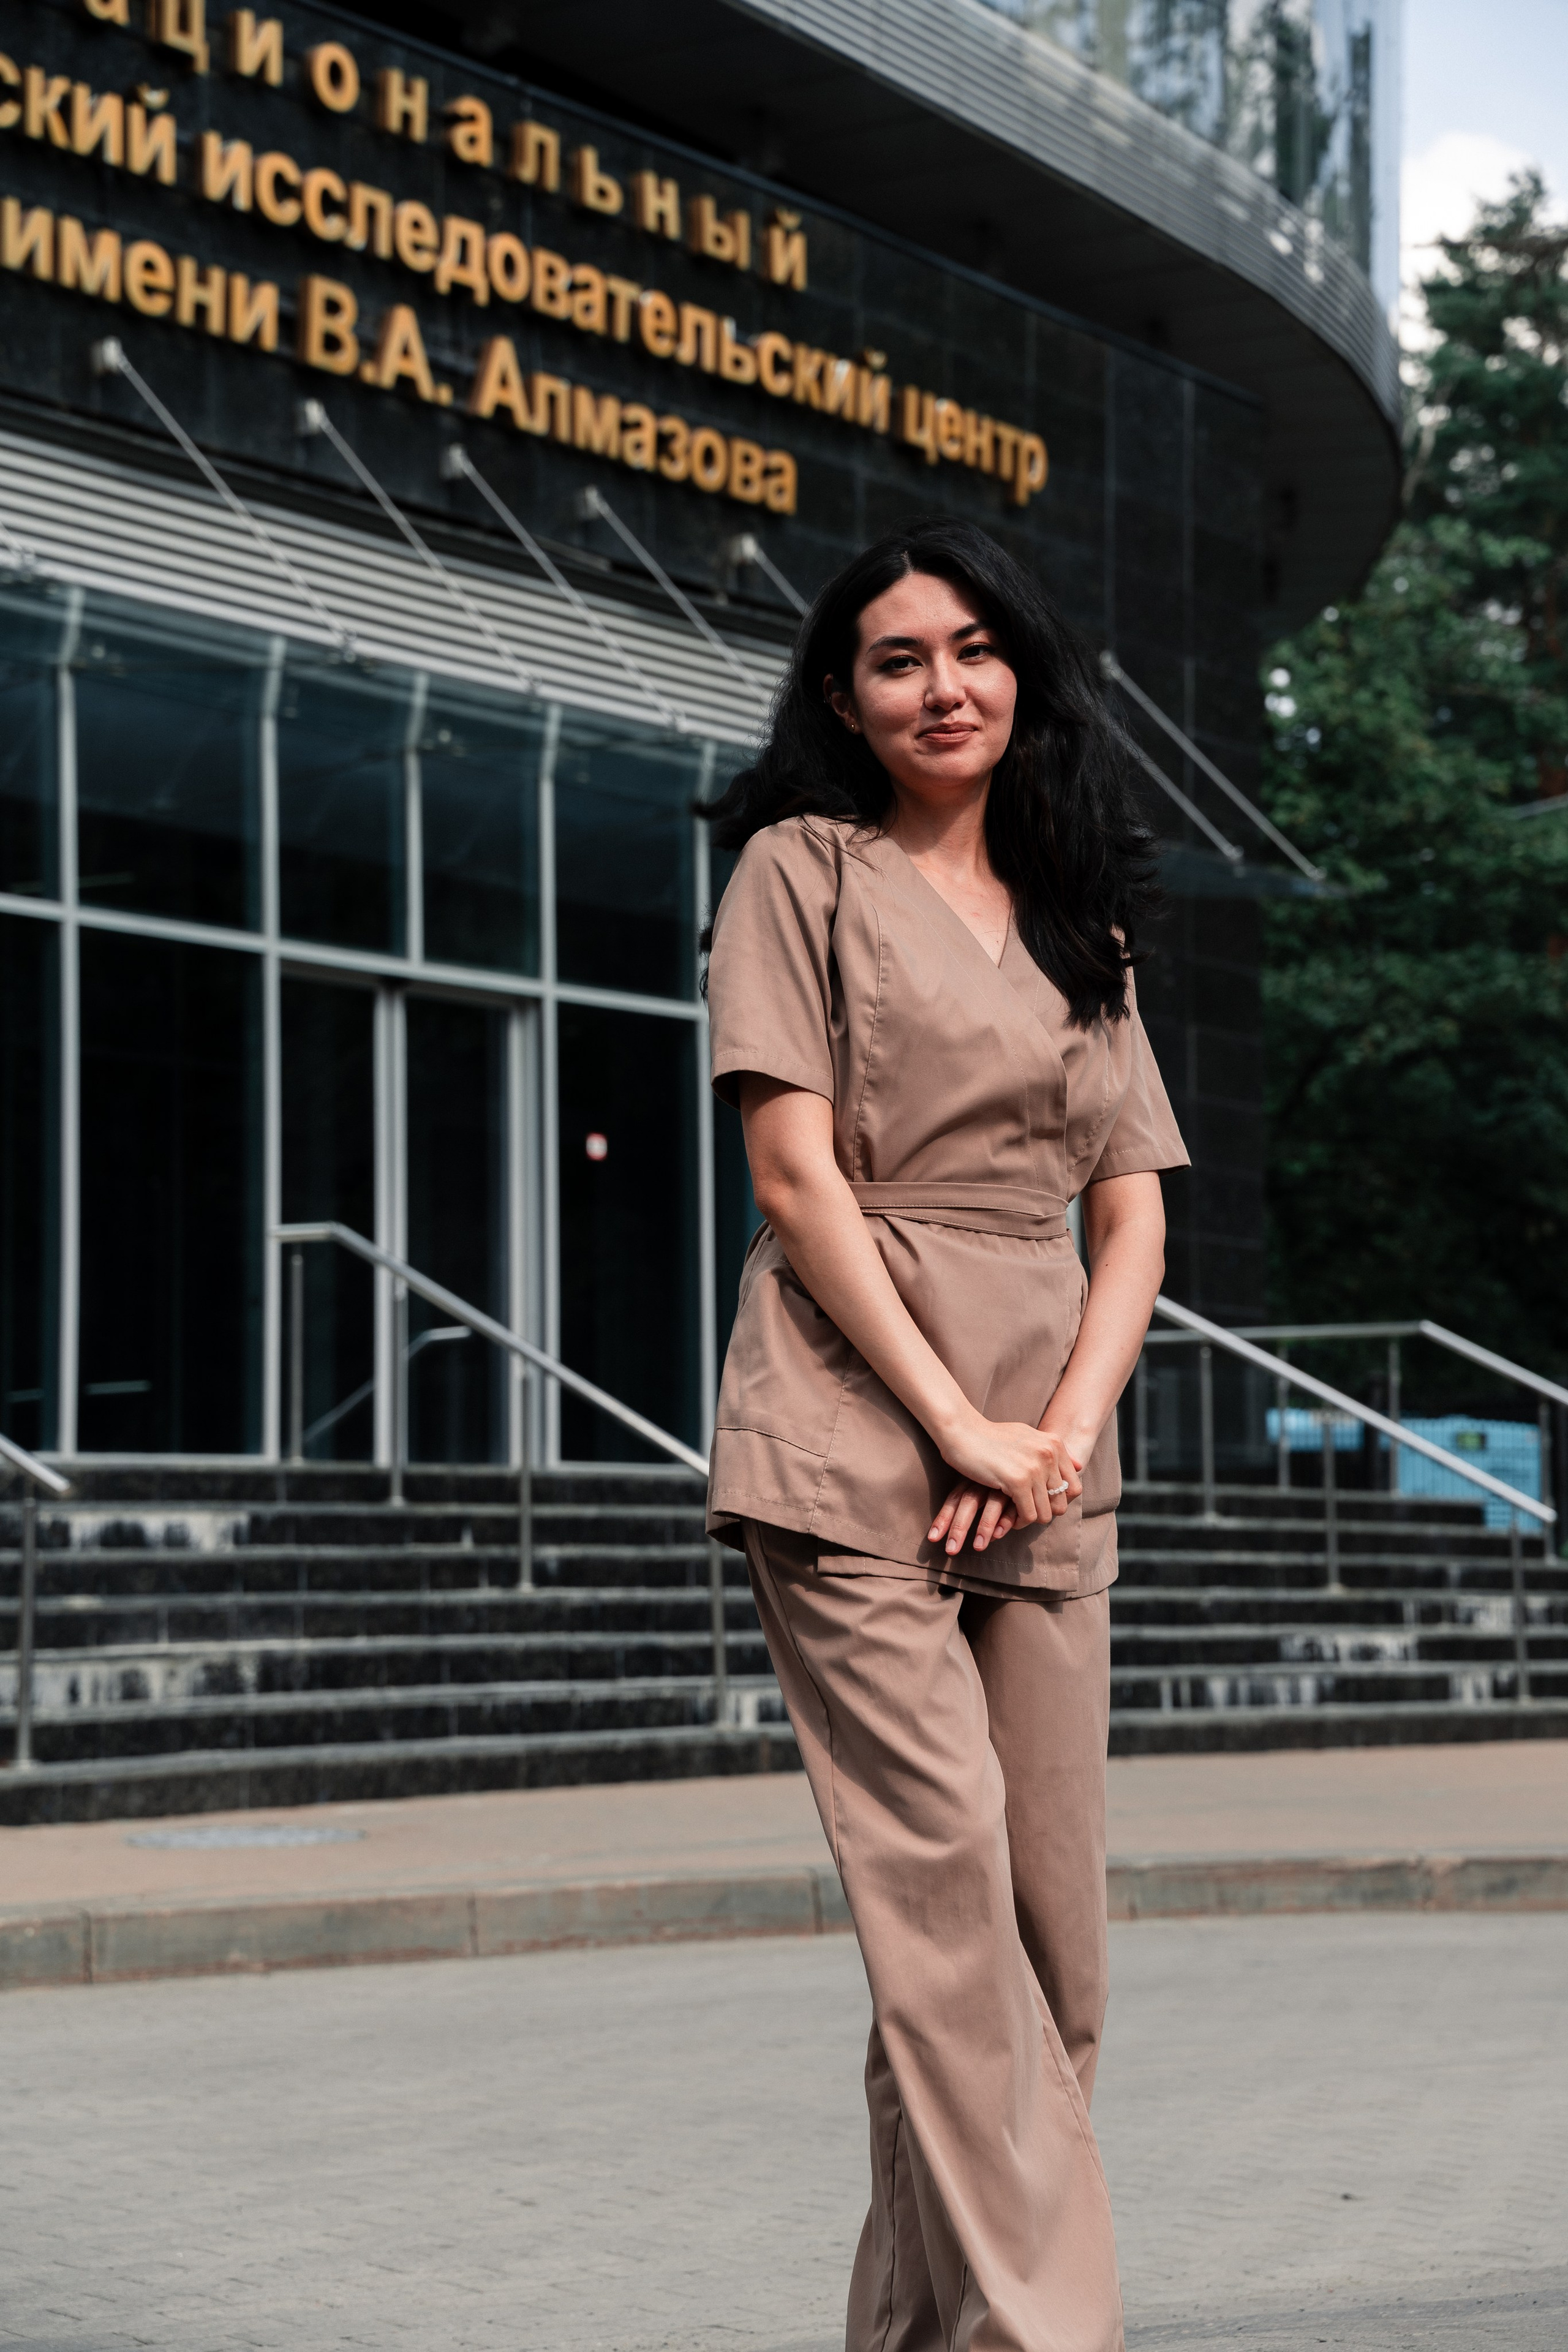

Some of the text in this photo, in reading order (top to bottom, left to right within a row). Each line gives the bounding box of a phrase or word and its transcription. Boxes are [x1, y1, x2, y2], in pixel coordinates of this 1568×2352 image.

[0, 196, 797, 515] имени В.А. Алмазова
[201, 130, 891, 434] исследовательский
[900, 385, 1047, 506] центр
